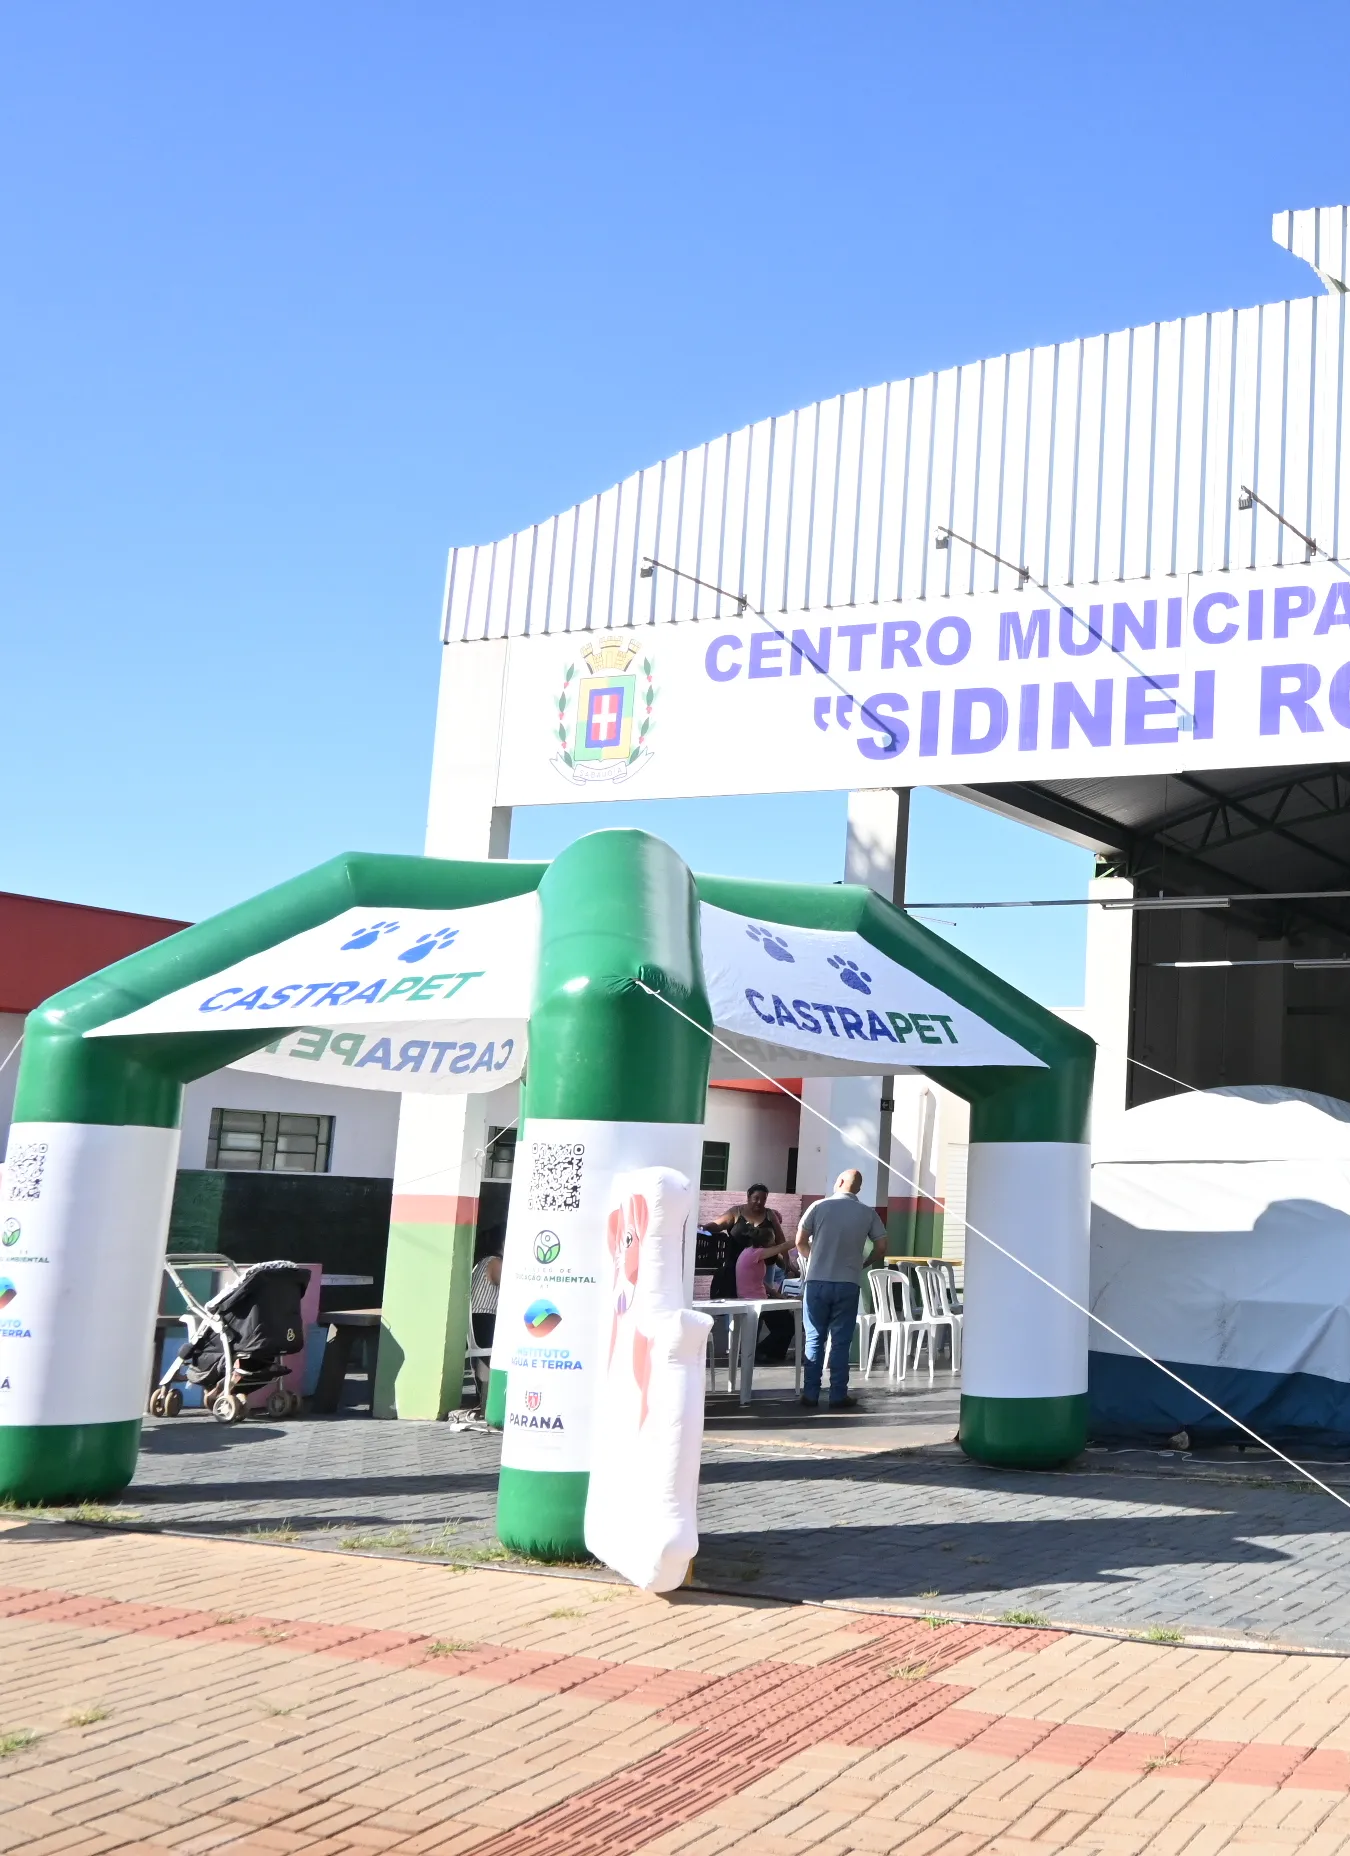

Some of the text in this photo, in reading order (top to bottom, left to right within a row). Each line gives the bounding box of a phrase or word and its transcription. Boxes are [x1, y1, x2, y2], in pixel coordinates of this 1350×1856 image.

[706, 616, 972, 682] CENTRO
[199, 971, 486, 1013] CASTRAPET
[744, 988, 959, 1045] CASTRAPET
[543, 1275, 596, 1284] AMBIENTAL
[531, 1359, 538, 1369] E
[541, 1360, 583, 1370] TERRA
[510, 1412, 564, 1430] PARANÁ
